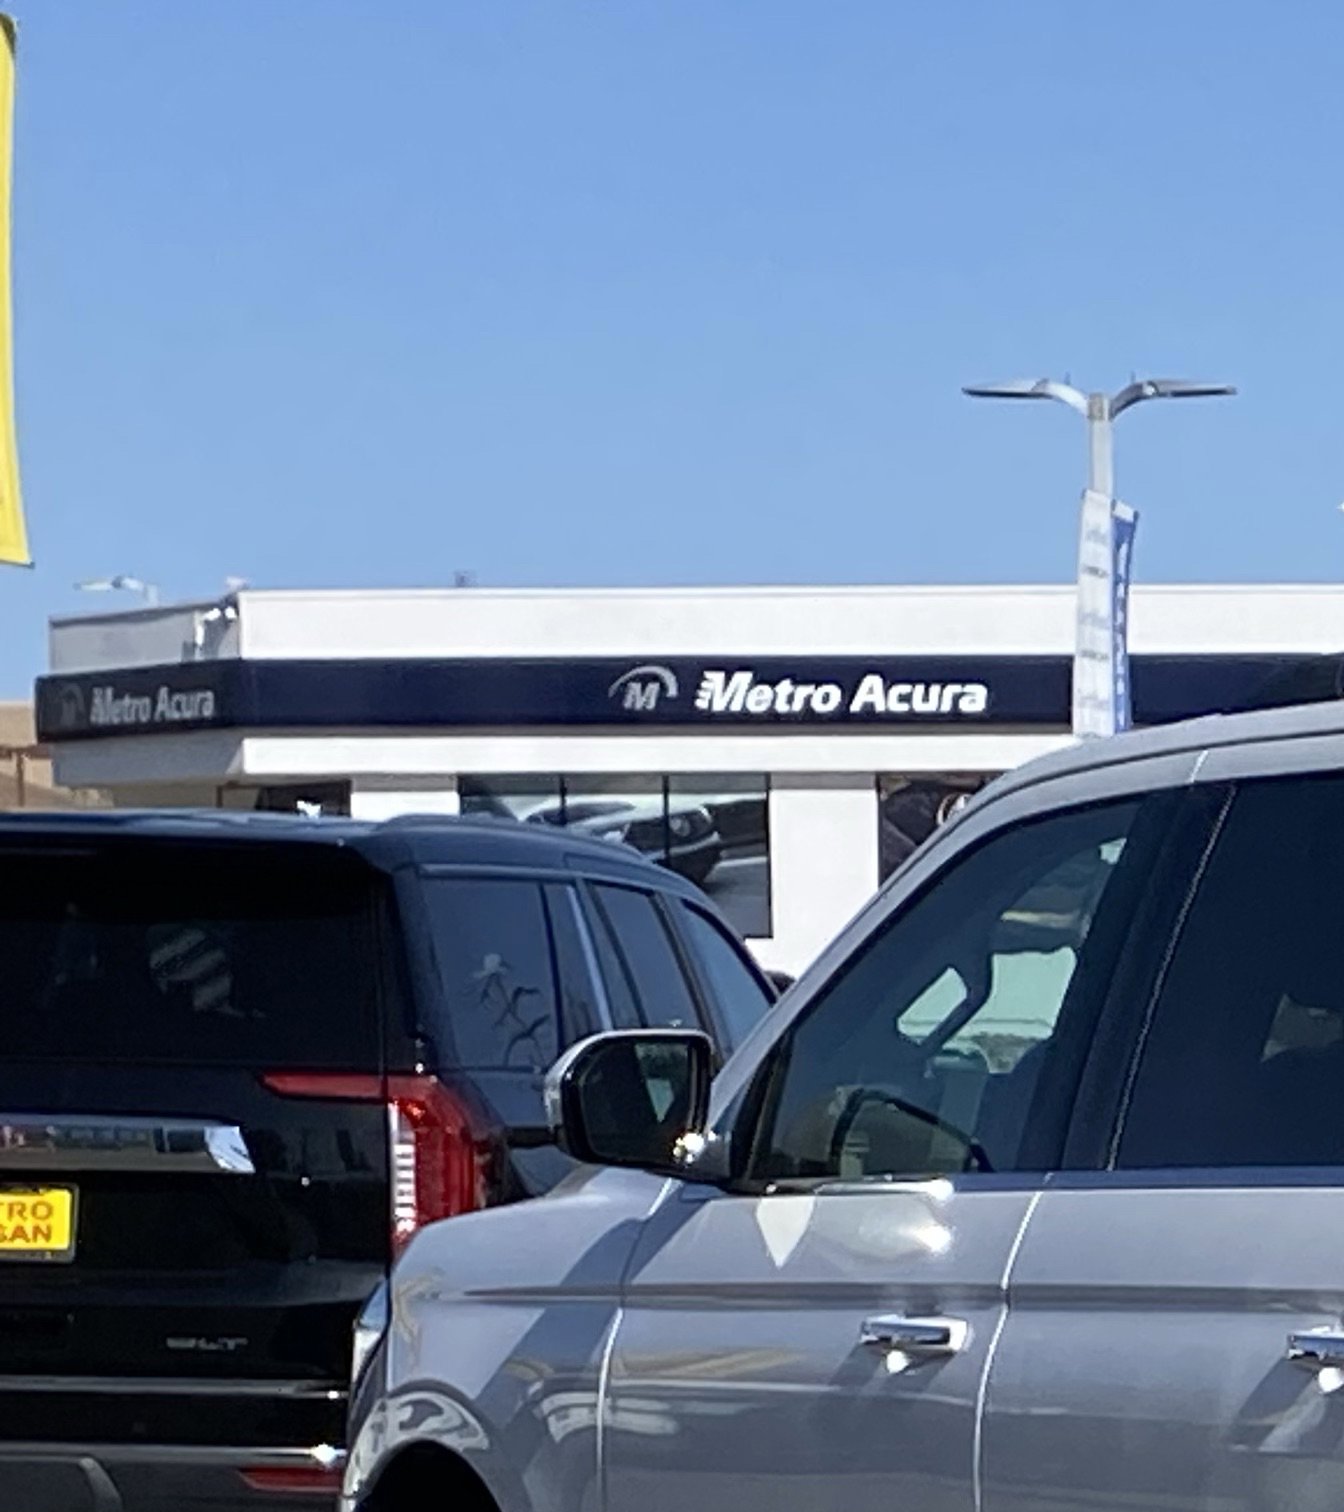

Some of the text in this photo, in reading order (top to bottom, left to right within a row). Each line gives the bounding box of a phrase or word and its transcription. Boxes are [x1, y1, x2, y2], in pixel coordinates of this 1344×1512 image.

[90, 685, 215, 725] Metro Acura
[694, 671, 989, 713] Metro Acura
